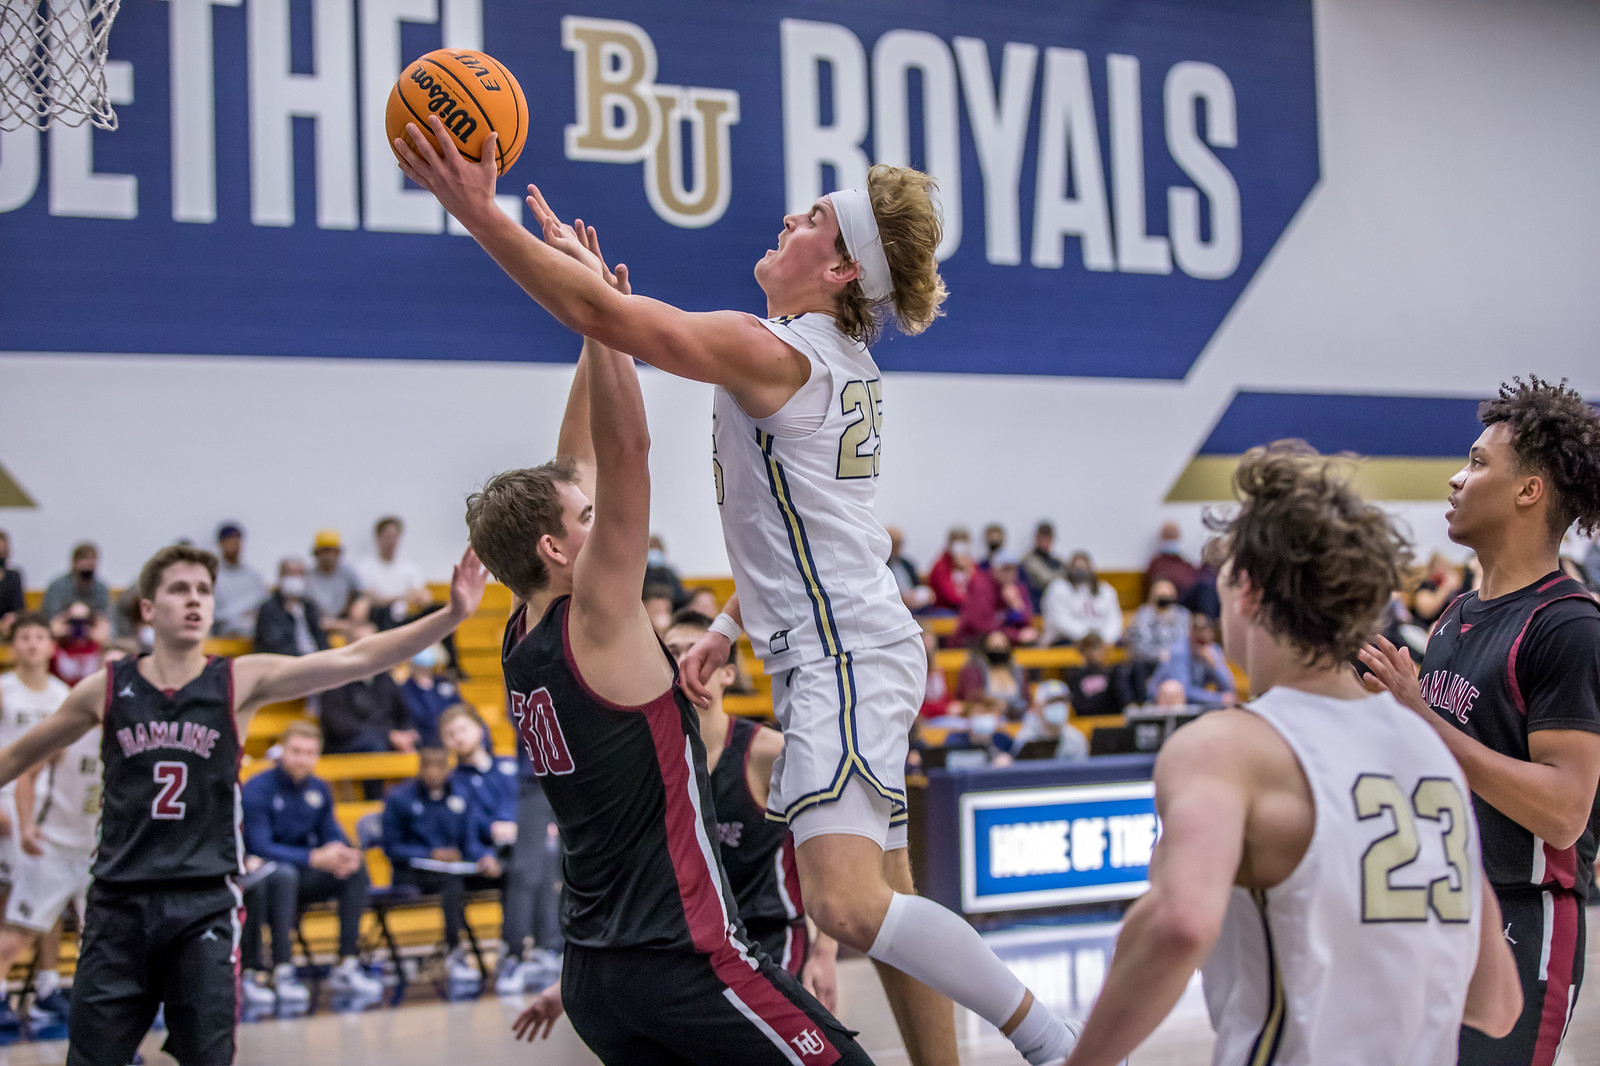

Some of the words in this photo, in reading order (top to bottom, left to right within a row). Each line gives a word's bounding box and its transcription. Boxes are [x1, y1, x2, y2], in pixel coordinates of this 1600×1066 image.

[410, 65, 478, 144] Wilson
[562, 16, 740, 228] BU
[780, 18, 1242, 280] ROYALS
[1418, 670, 1481, 724] AMLINE
[116, 720, 221, 759] HAMLINE
[151, 761, 188, 820] 2
[1350, 773, 1472, 923] 23
